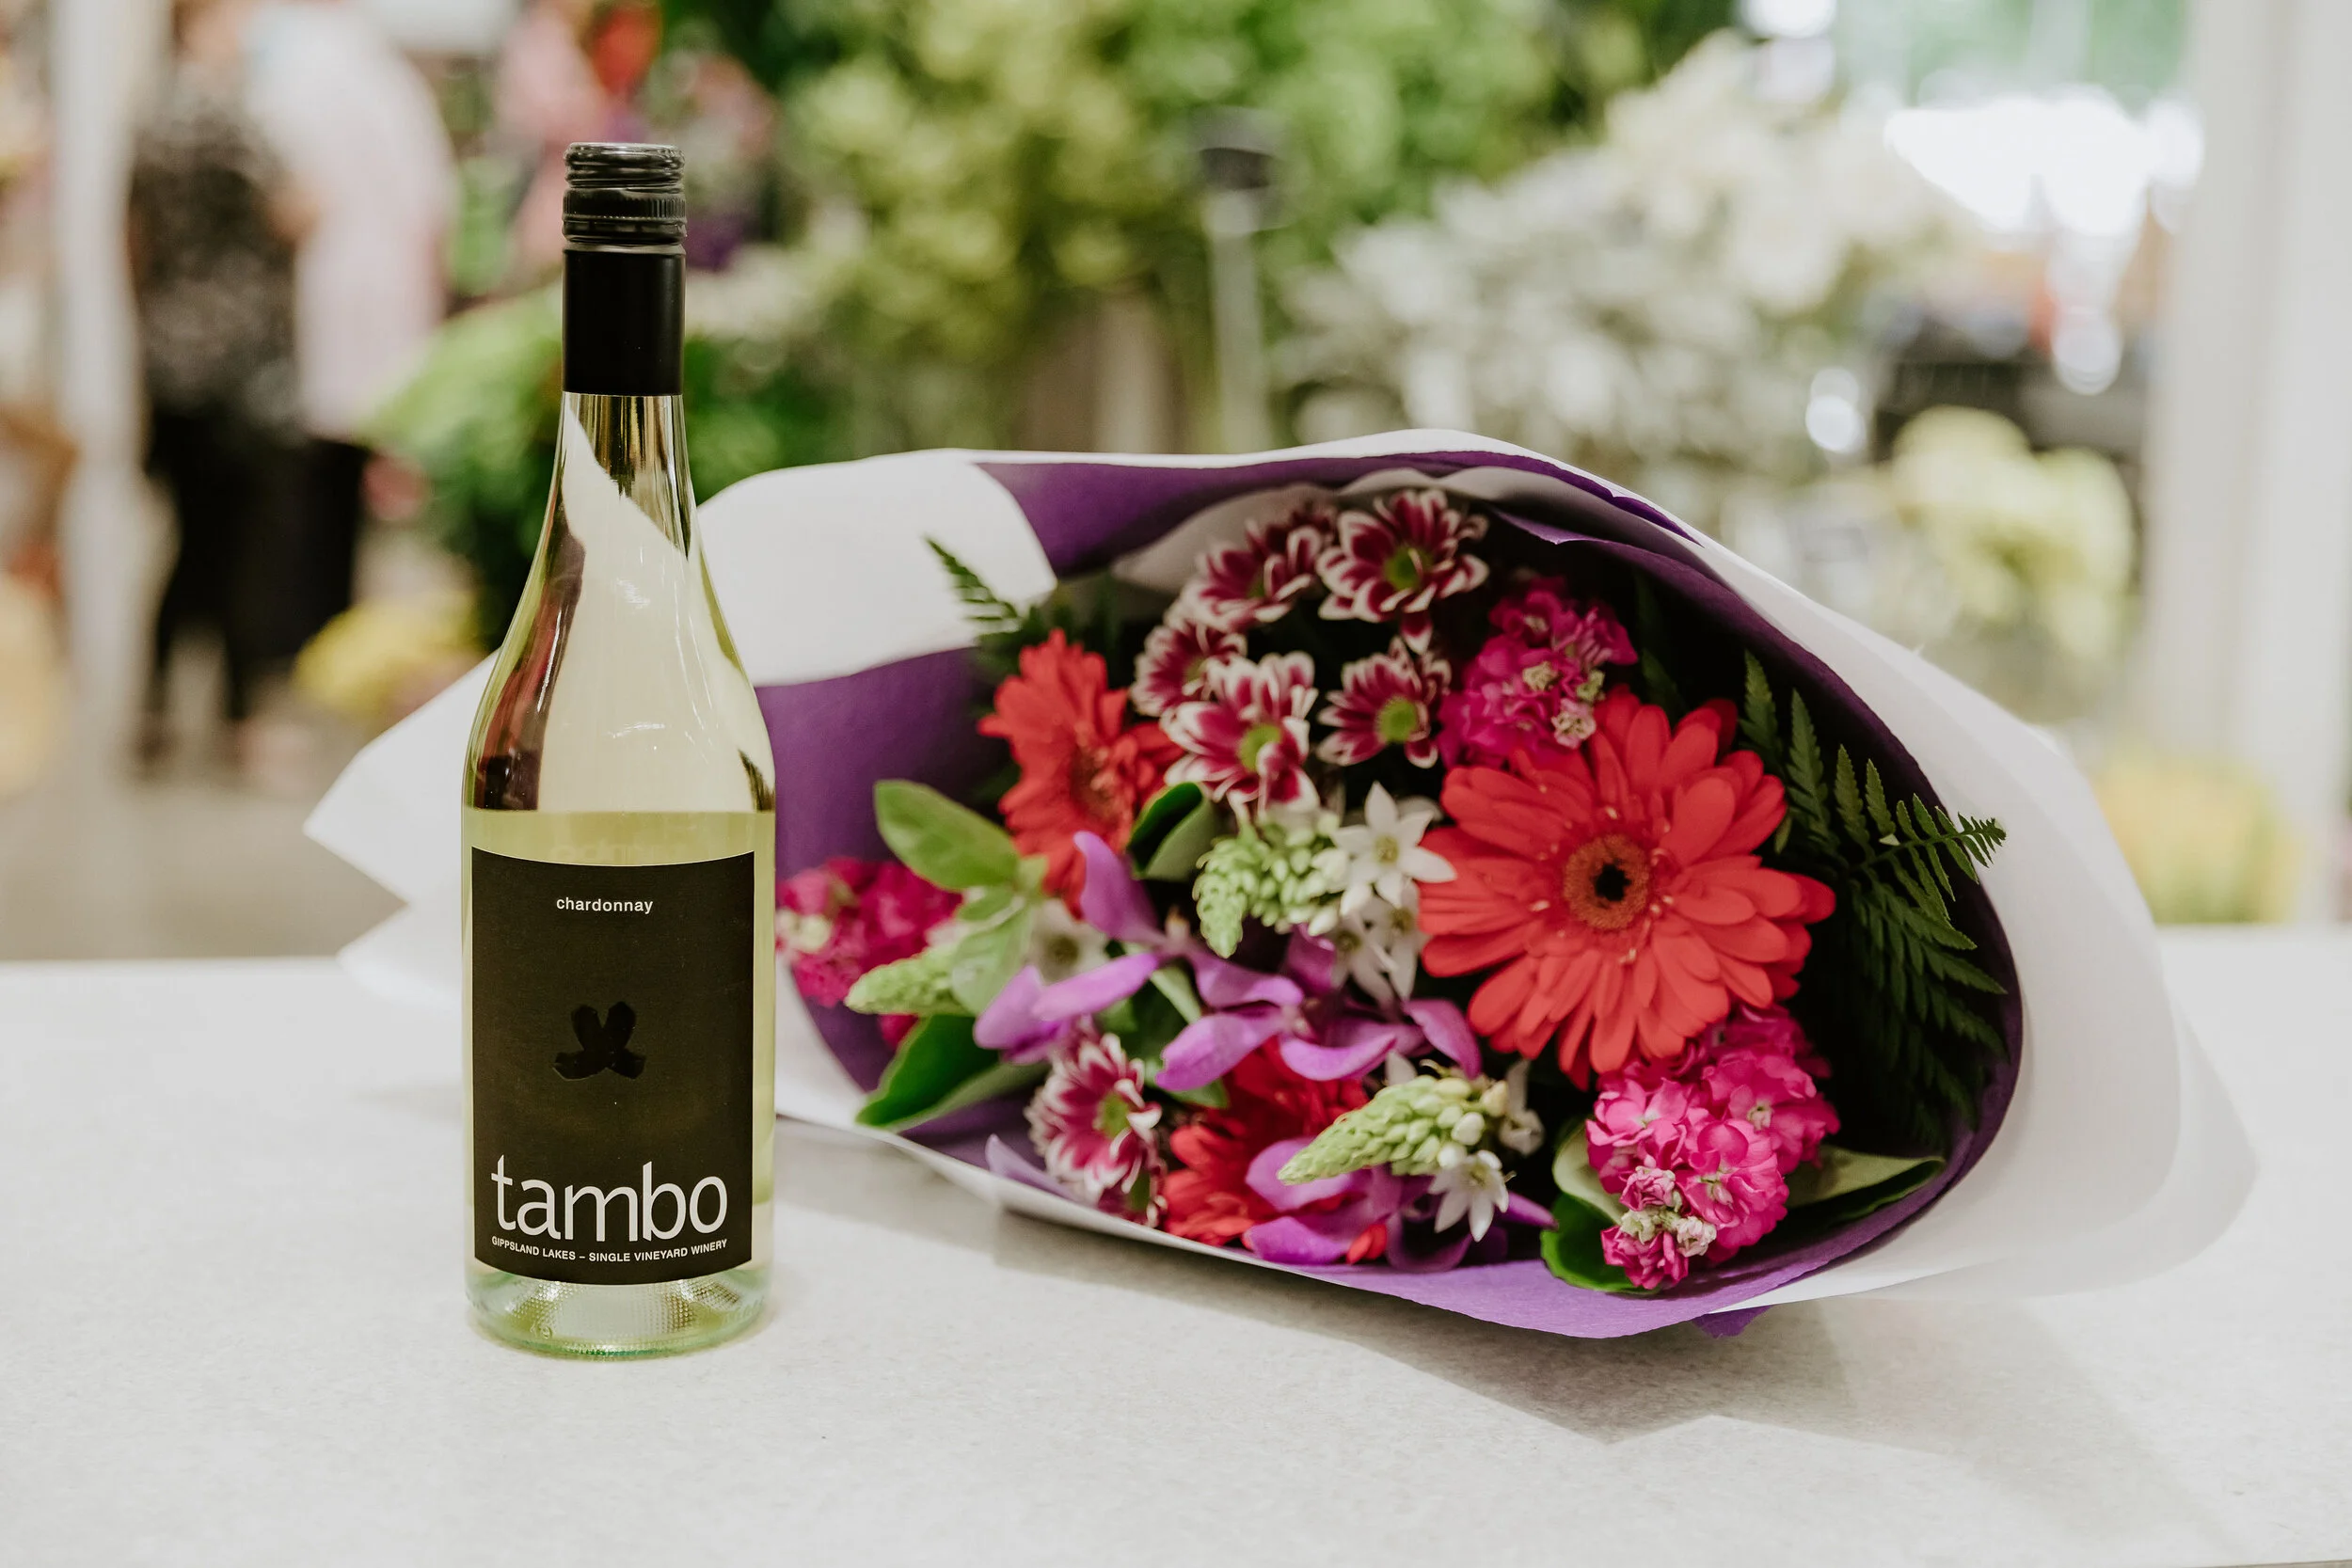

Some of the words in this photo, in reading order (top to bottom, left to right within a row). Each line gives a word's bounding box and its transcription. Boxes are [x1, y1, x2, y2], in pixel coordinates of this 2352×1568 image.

[556, 896, 653, 915] chardonnay
[490, 1154, 728, 1243] tambo
[491, 1235, 540, 1256] GIPPSLAND
[543, 1247, 576, 1260] LAKES
[589, 1252, 630, 1262] SINGLE
[634, 1246, 688, 1261] VINEYARD
[691, 1238, 728, 1256] WINERY
